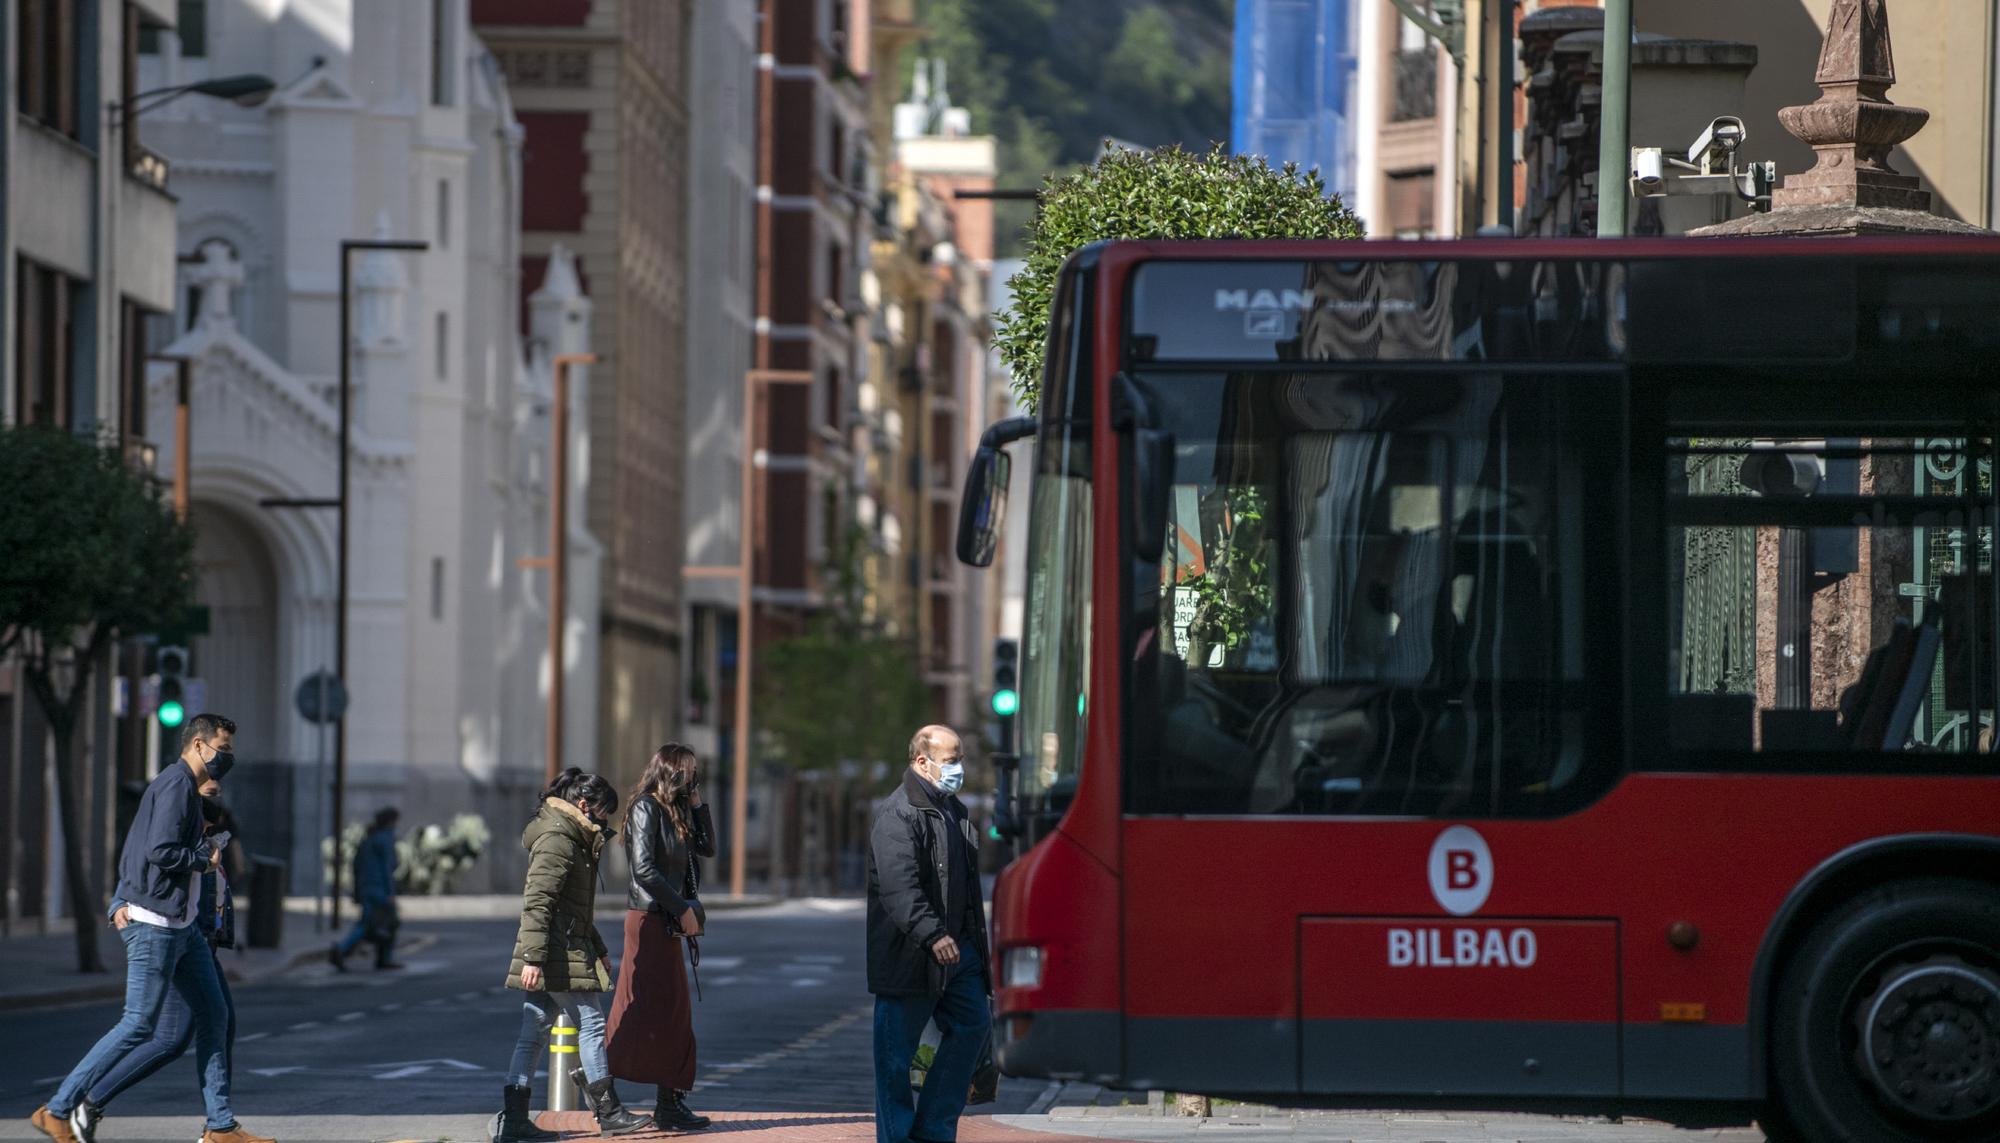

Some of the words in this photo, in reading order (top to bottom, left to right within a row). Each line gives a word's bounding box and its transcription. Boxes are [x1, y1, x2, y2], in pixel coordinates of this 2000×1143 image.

[1215, 289, 1314, 308] MAN
[1446, 850, 1479, 890] B
[1387, 928, 1537, 968] BILBAO
